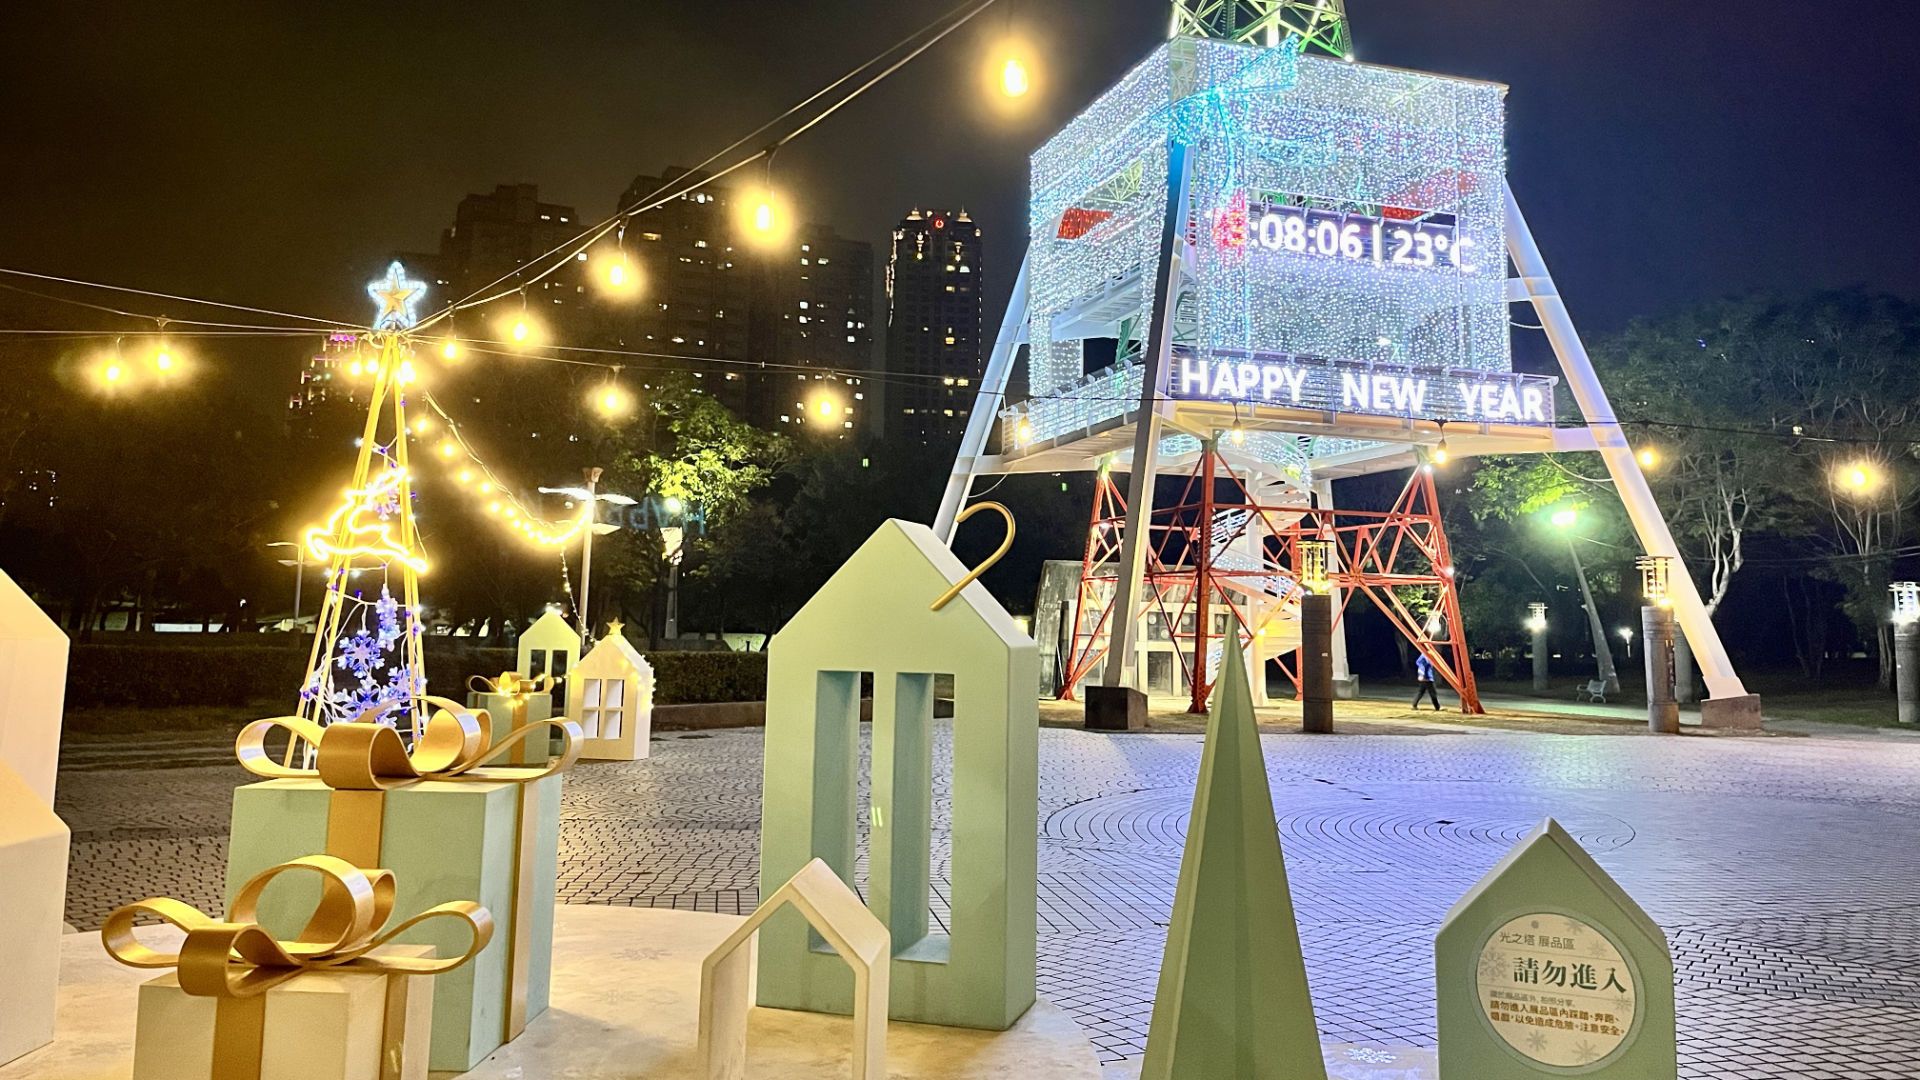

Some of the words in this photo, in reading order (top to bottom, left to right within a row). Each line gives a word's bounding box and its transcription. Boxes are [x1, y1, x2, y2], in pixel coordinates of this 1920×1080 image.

[1226, 210, 1363, 260] :08:06
[1180, 356, 1307, 403] HAPPY
[1342, 371, 1427, 414] NEW
[1458, 382, 1546, 423] YEAR
[1499, 931, 1535, 947] 光之塔
[1538, 935, 1576, 950] 展品區
[1512, 957, 1627, 994] 請勿進入
